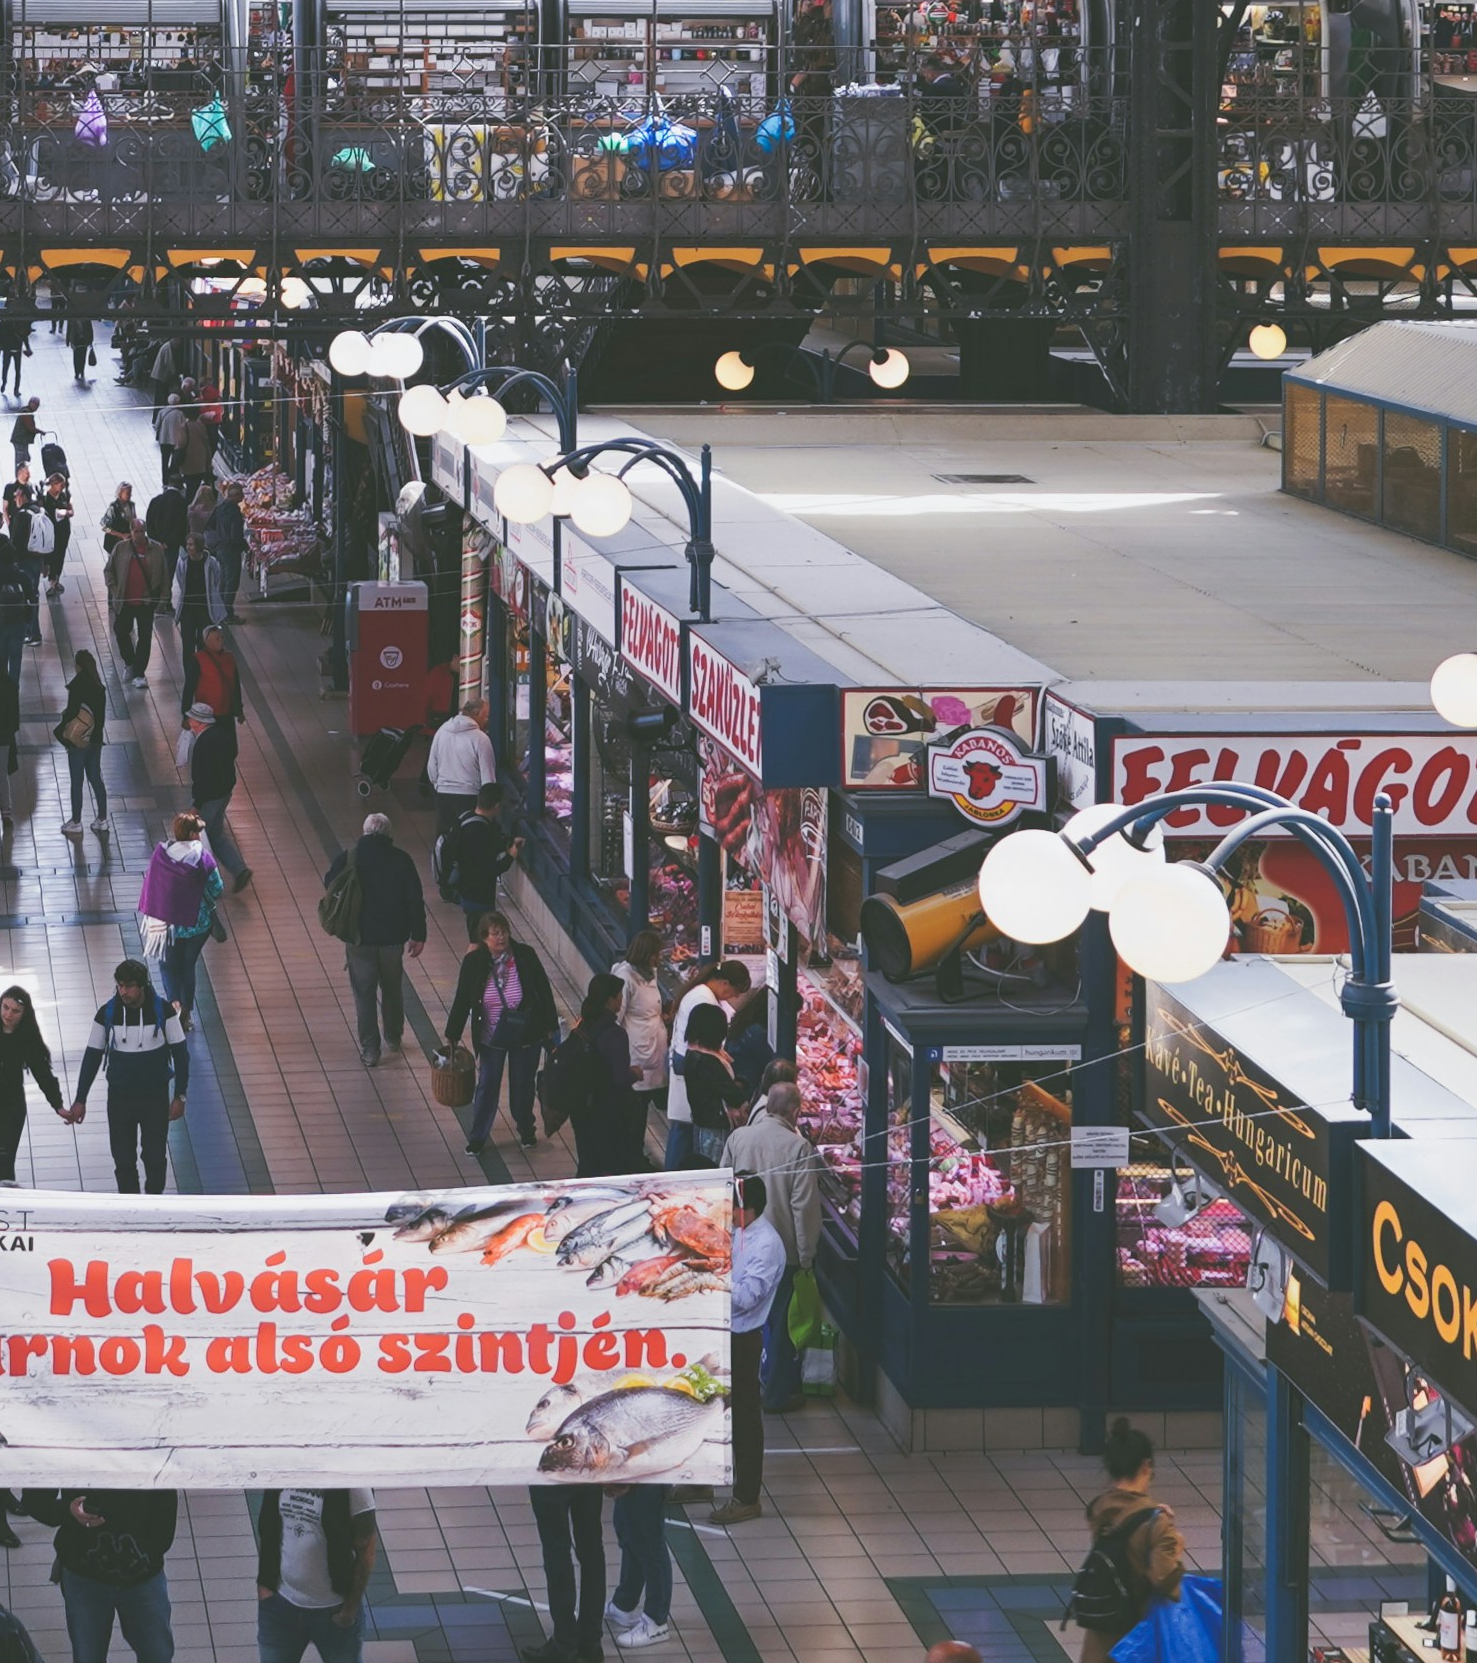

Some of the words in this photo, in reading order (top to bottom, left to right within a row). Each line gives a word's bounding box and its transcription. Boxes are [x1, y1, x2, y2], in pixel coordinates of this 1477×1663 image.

[374, 597, 402, 609] ATM
[954, 739, 1013, 765] KABANOS
[1145, 1025, 1181, 1085] Kavé
[1188, 1060, 1213, 1115] Tea
[1222, 1089, 1328, 1213] Hungaricum
[48, 1247, 448, 1318] Halvásár
[206, 1313, 362, 1375] alsó
[378, 1311, 689, 1386] szintjén.
